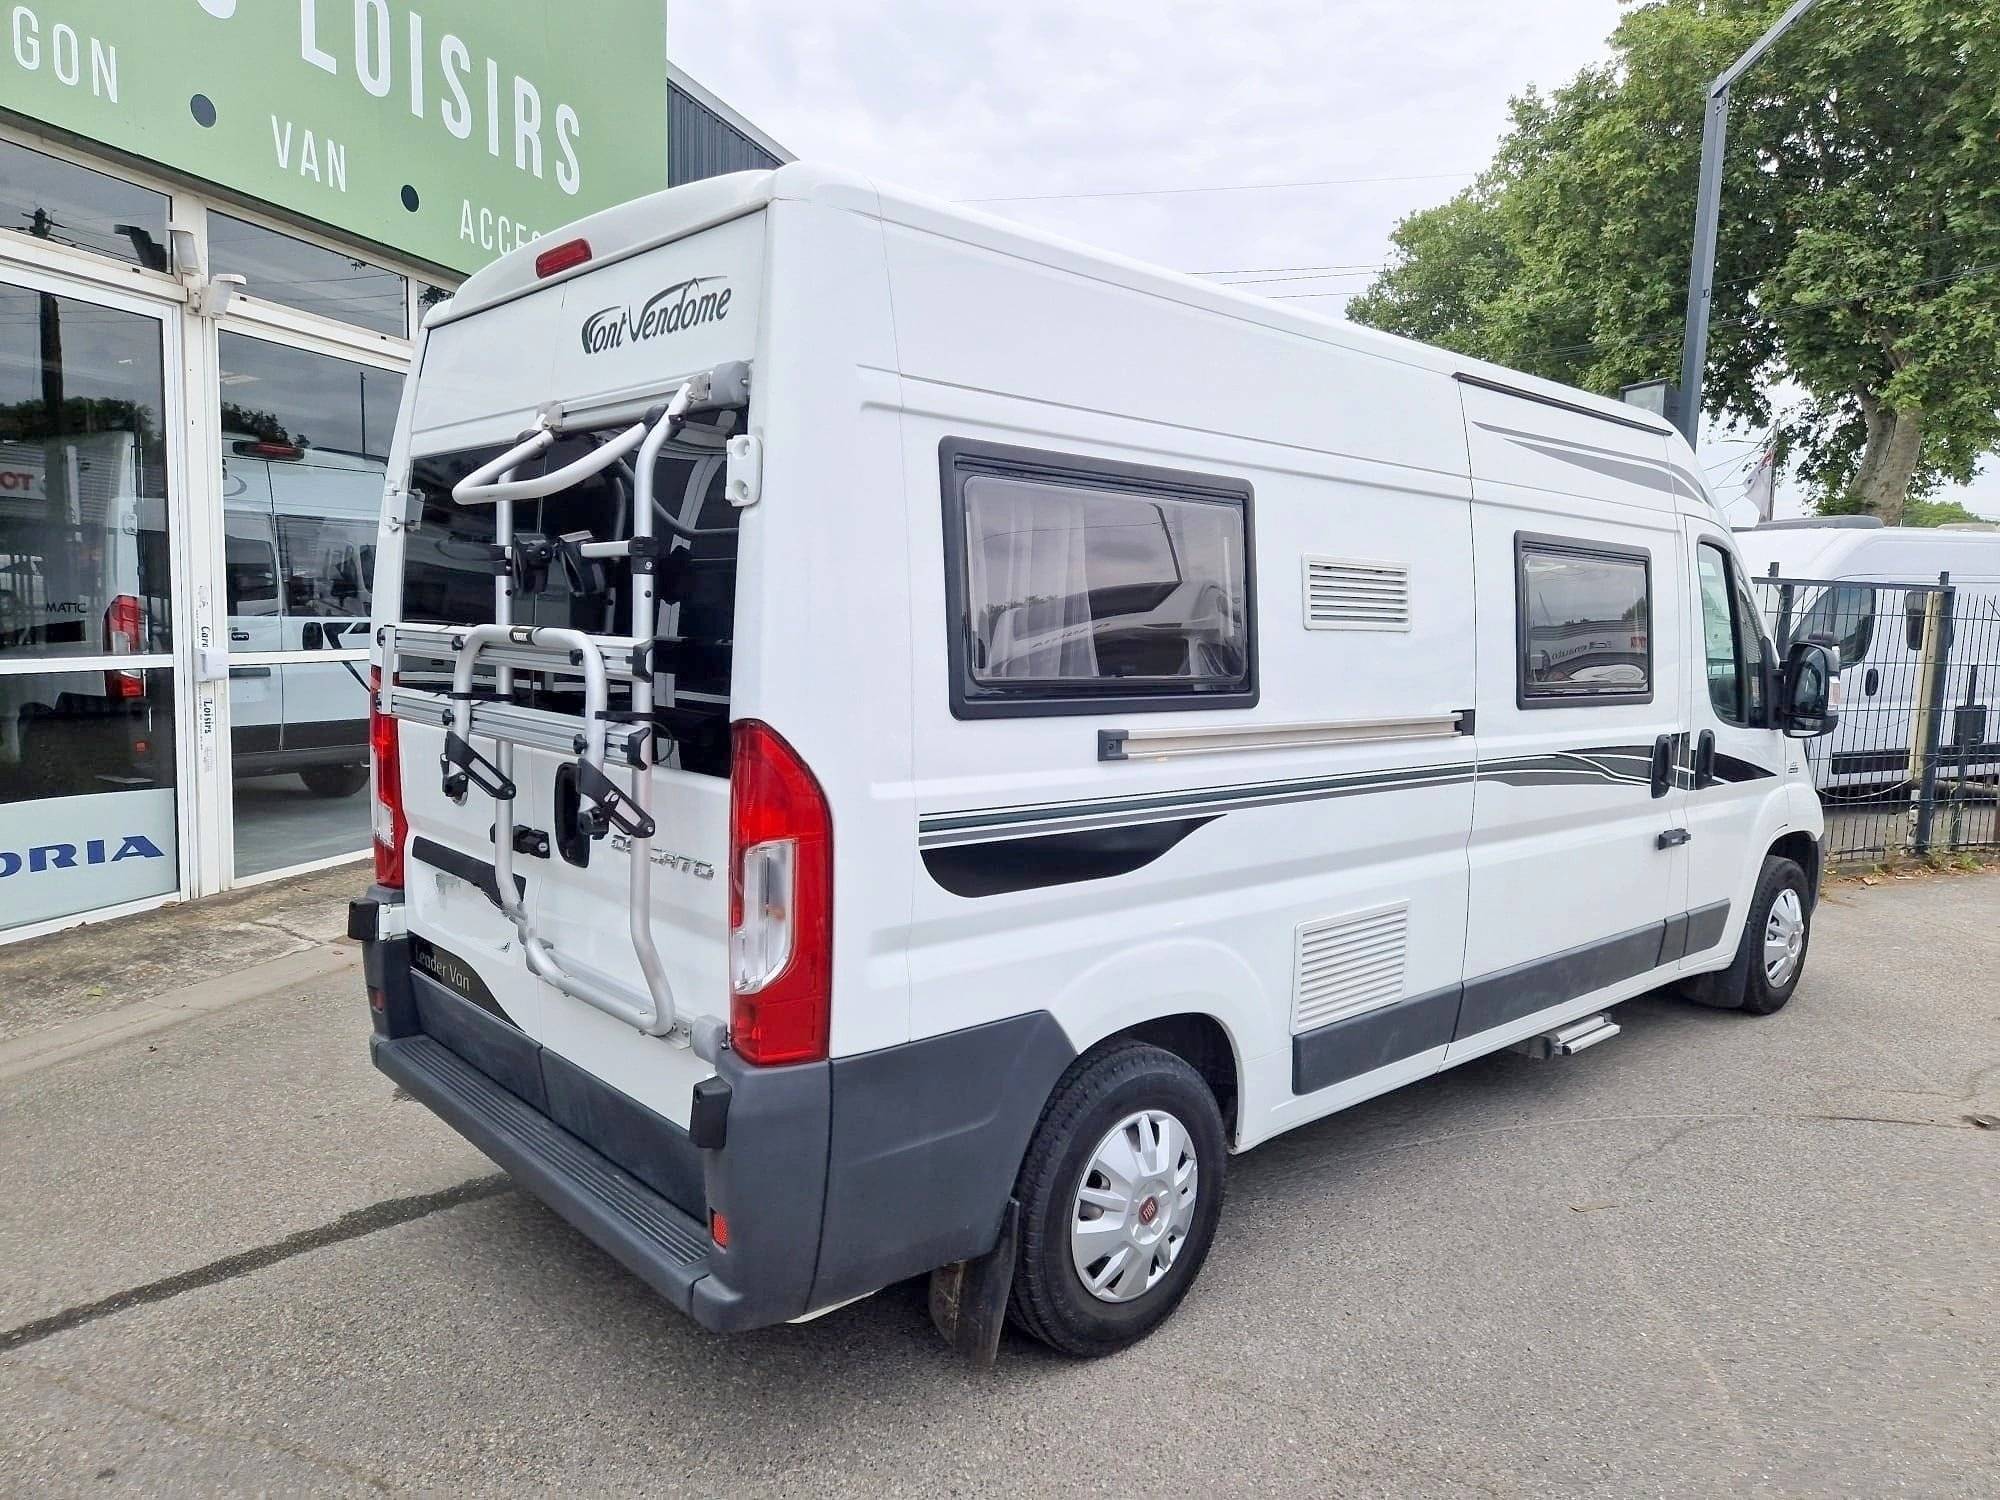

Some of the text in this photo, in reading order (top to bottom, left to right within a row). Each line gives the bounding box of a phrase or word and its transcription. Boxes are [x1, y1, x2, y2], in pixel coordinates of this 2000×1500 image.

[12, 6, 541, 257] GON VAN ACCE
[300, 0, 580, 195] LOISIRS
[203, 698, 214, 735] Loisirs
[415, 940, 470, 992] Leader Van
